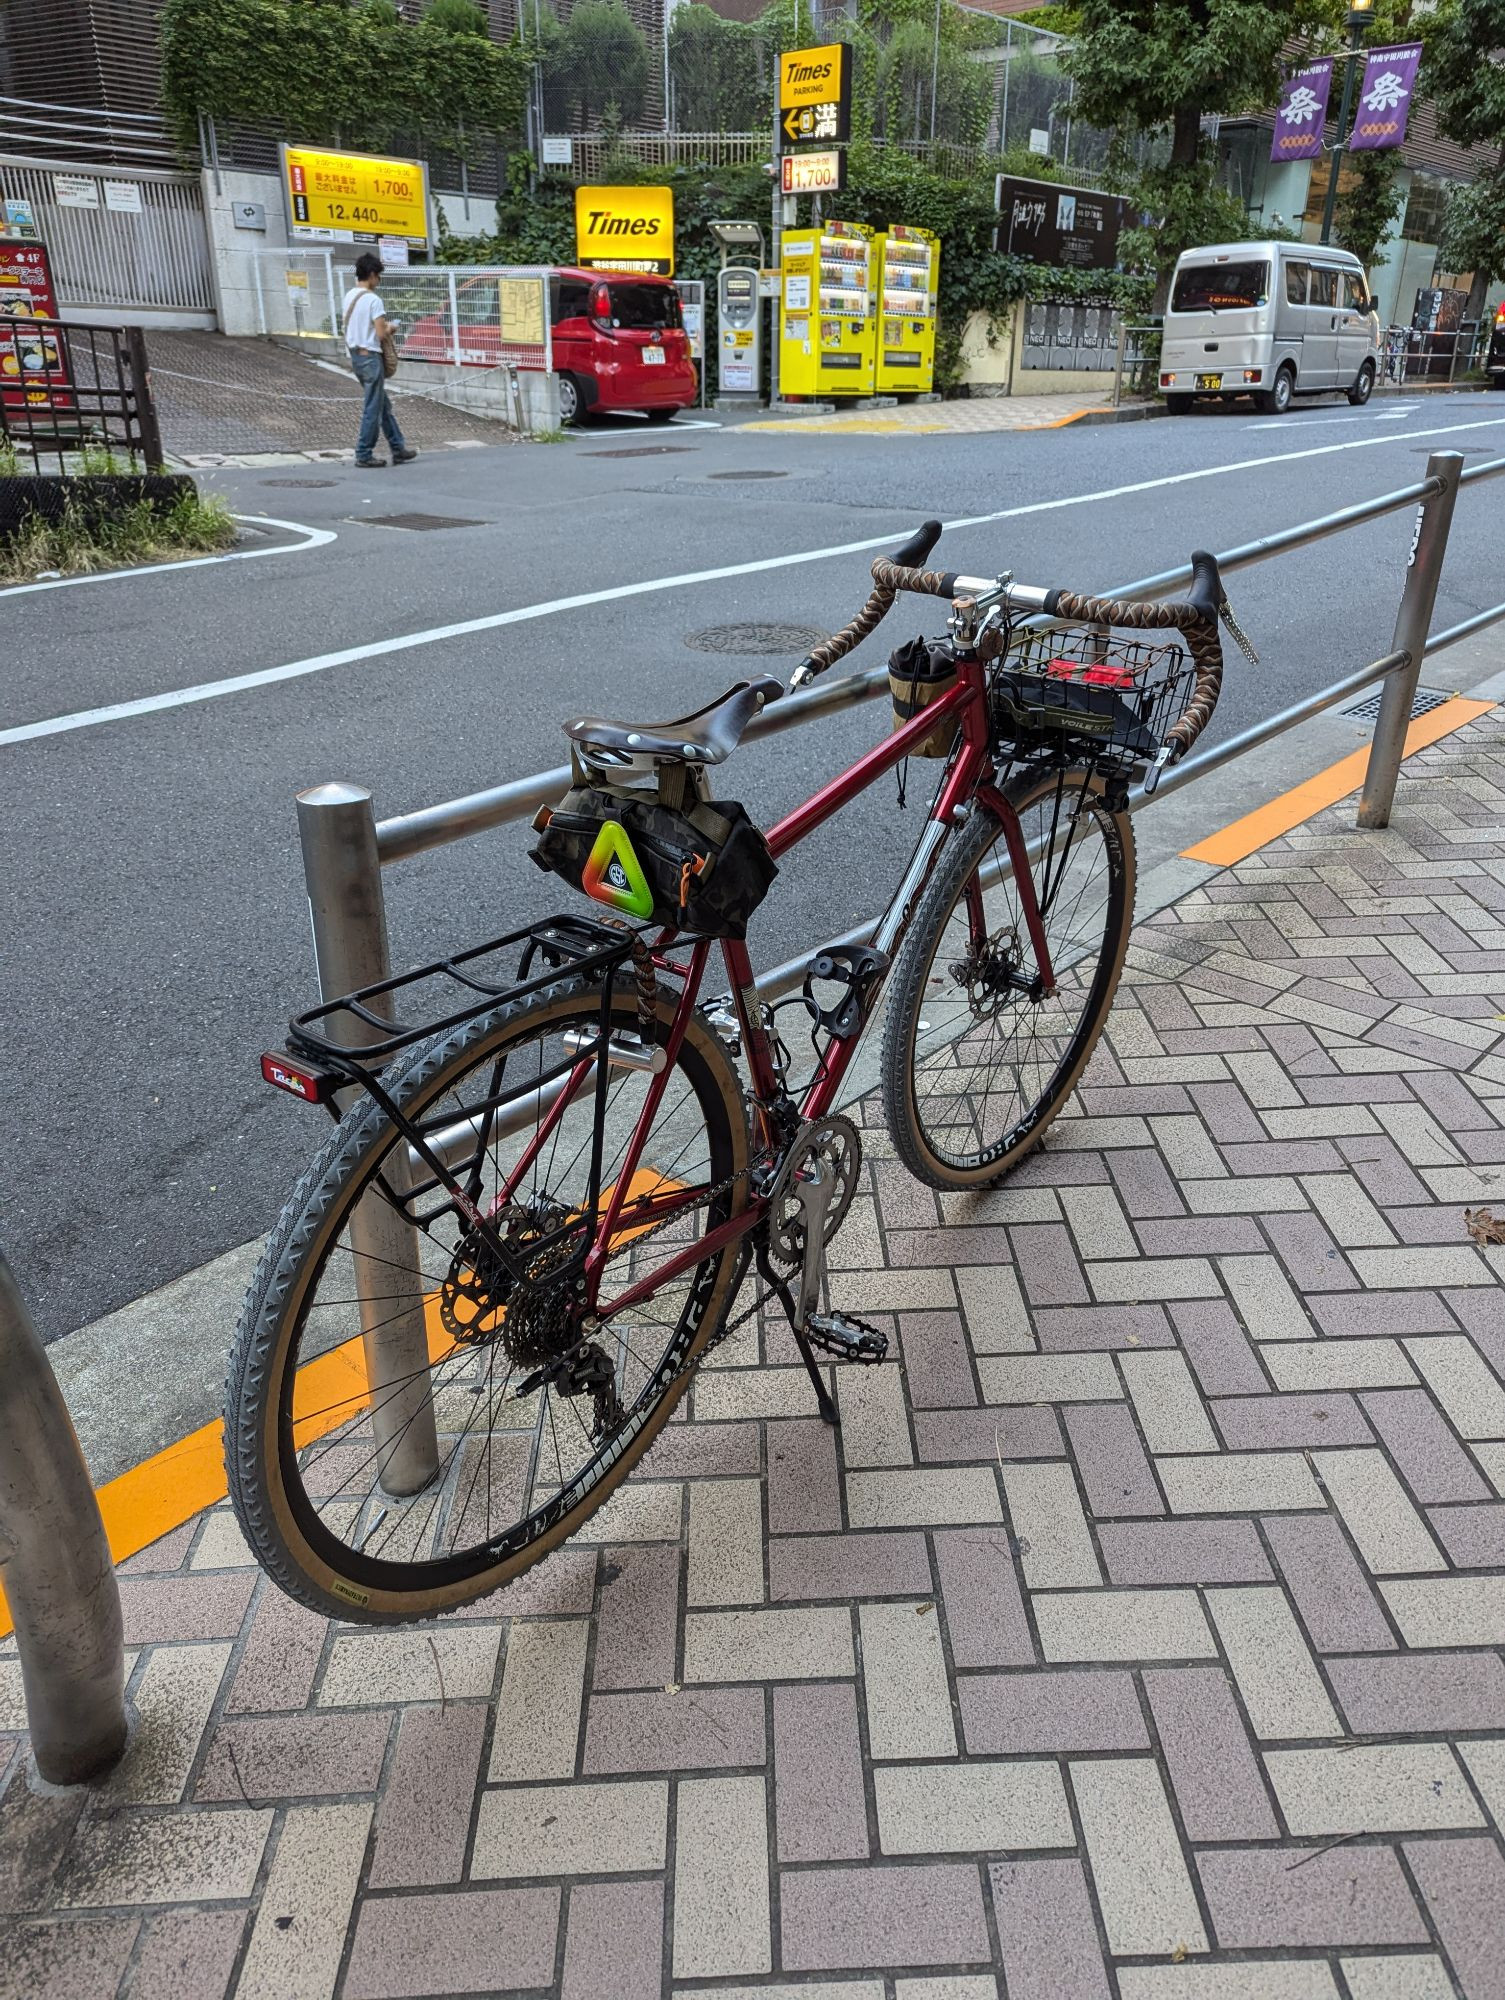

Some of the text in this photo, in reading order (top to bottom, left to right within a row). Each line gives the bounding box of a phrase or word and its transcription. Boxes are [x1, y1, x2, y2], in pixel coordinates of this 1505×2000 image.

[787, 63, 832, 83] Times
[793, 85, 823, 95] PARKING
[1363, 71, 1408, 112] 祭
[1280, 86, 1322, 125] 祭
[814, 104, 837, 138] 満
[316, 184, 358, 194] ございません
[588, 212, 661, 235] Times
[27, 254, 40, 263] 4F
[1060, 719, 1094, 730] VOILE
